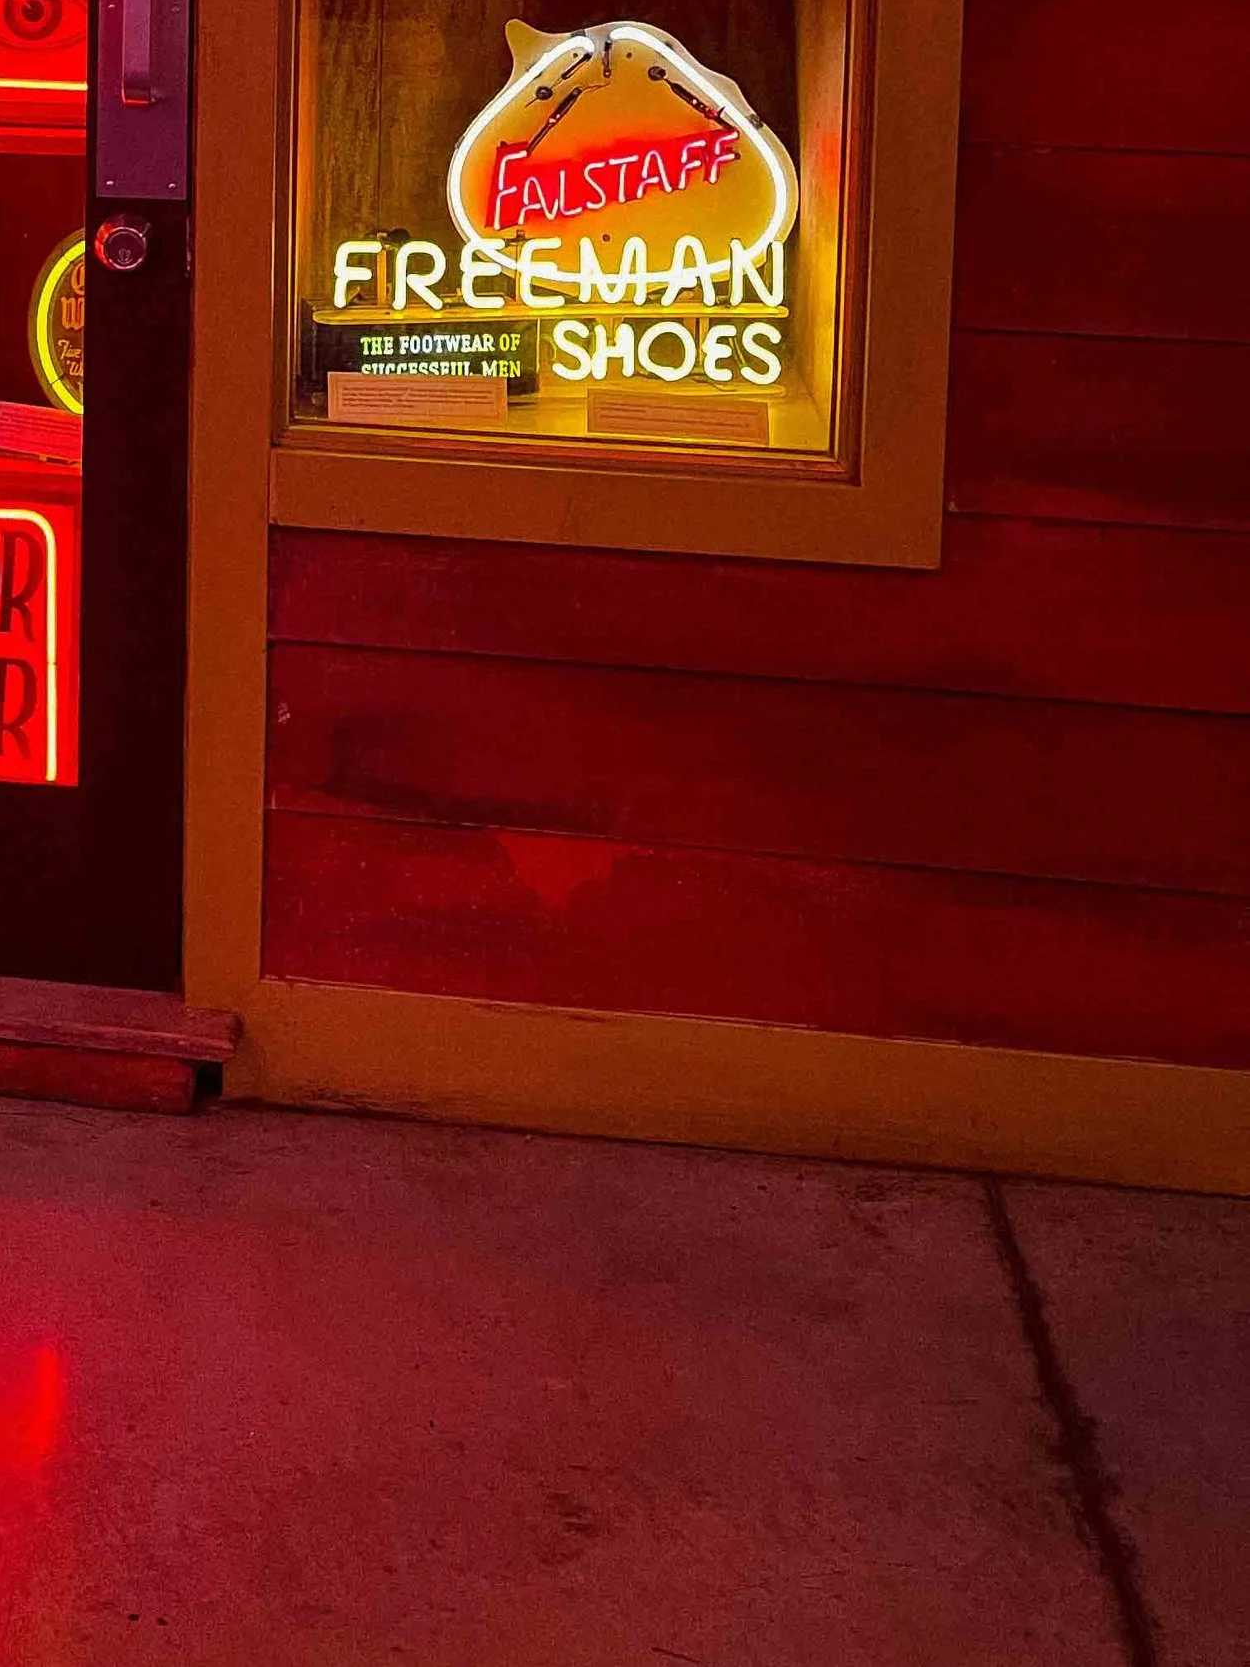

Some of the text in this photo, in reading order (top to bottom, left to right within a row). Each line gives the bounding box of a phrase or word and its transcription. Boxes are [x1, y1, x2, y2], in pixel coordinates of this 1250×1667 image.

[493, 131, 740, 230] FALSTAFF
[332, 236, 786, 311] FREEMAN
[361, 334, 521, 356] THE FOOTWEAR OF
[482, 361, 521, 378] MEN
[551, 319, 783, 385] SHOES
